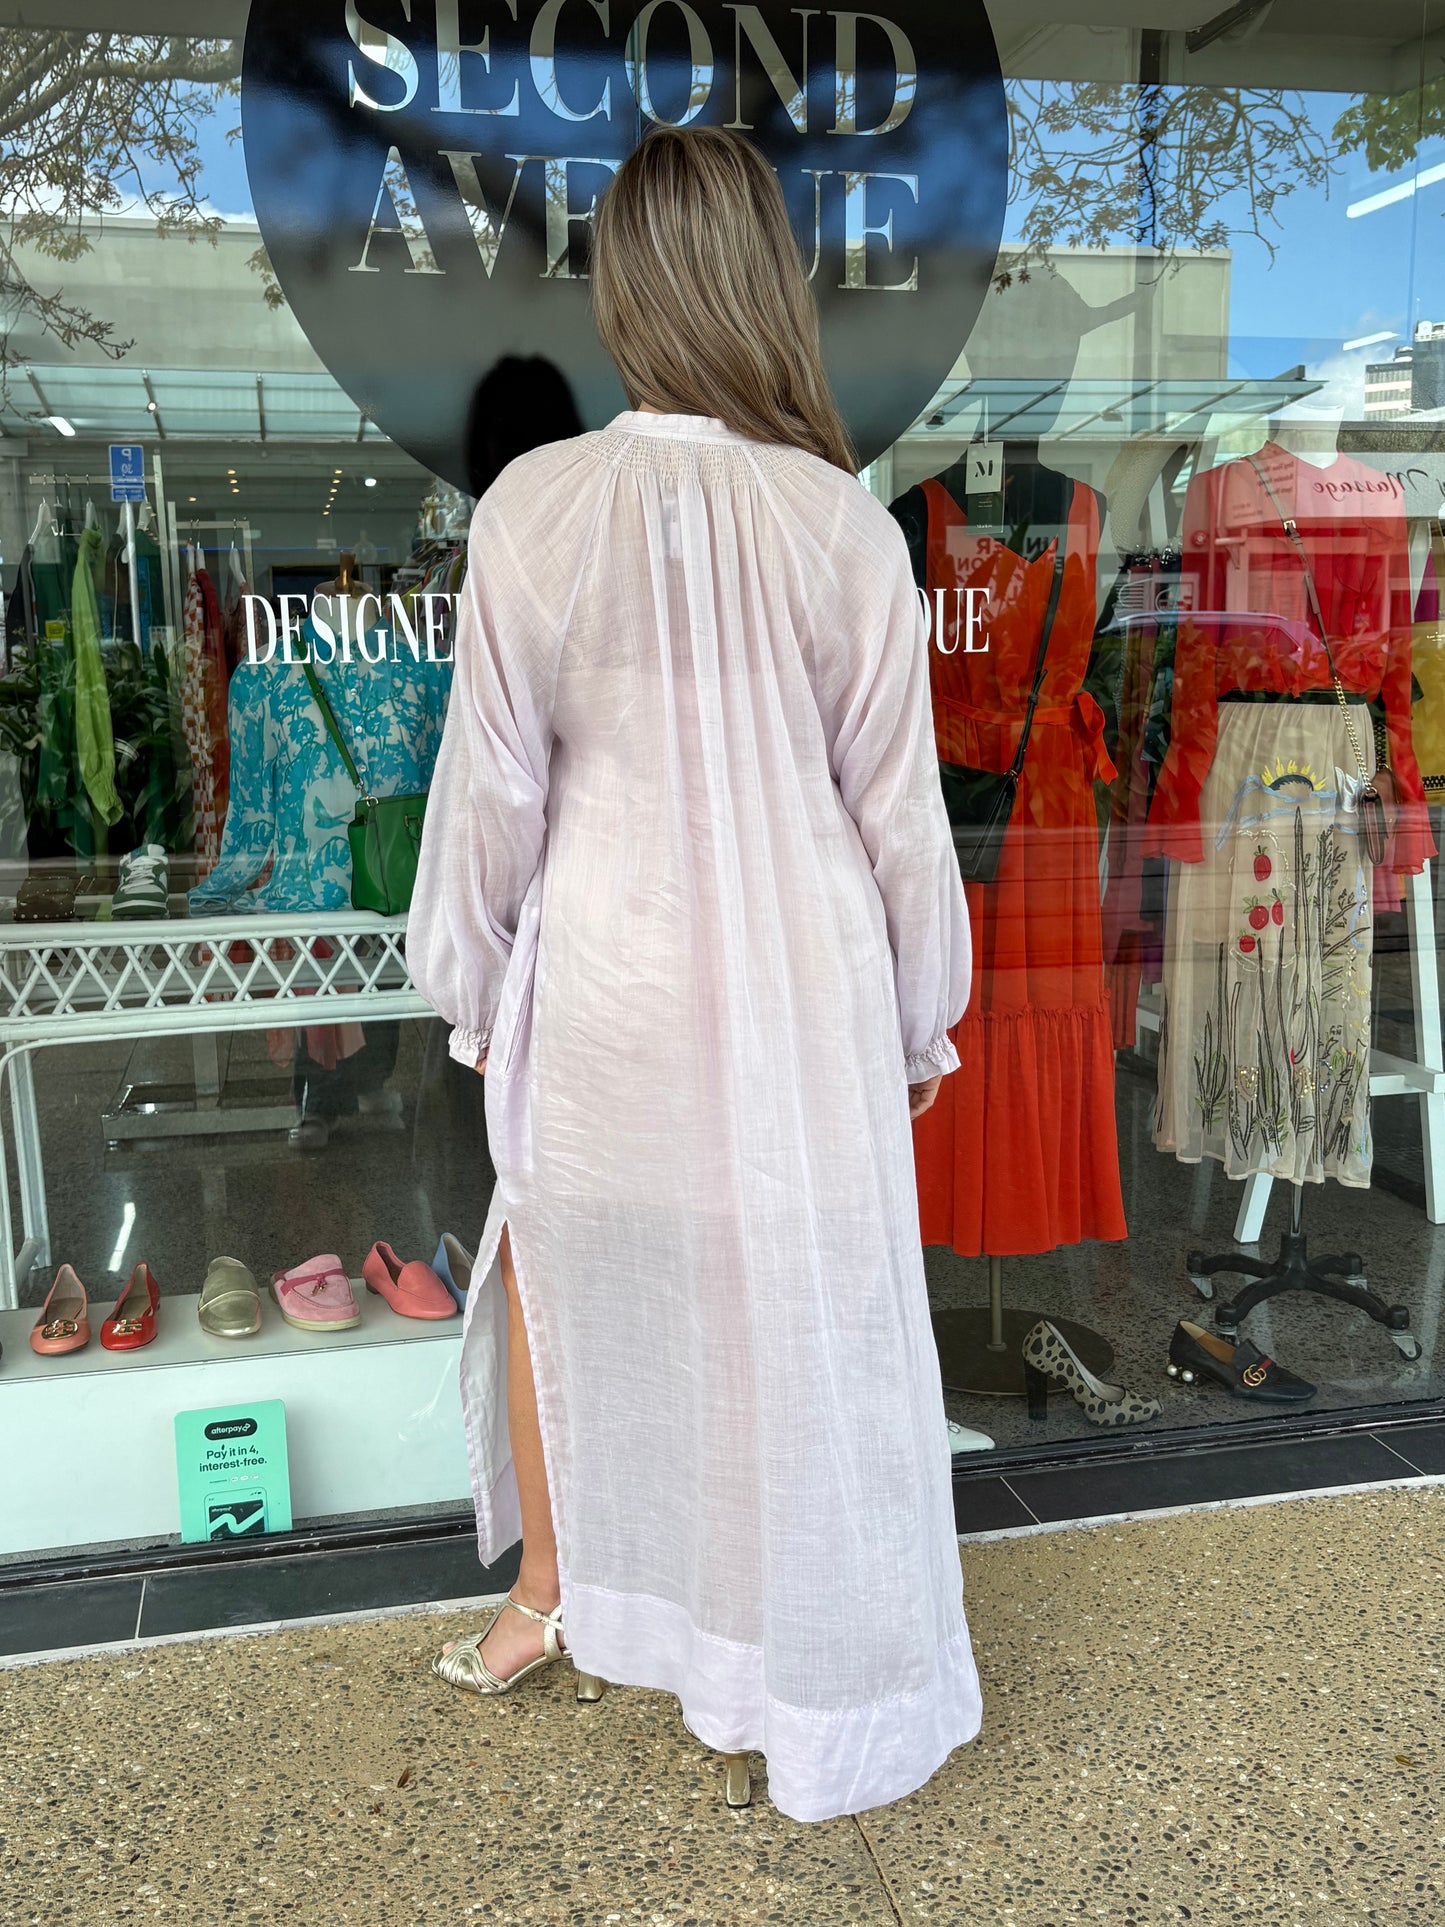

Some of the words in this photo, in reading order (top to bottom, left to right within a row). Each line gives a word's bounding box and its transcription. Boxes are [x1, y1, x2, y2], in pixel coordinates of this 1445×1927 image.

[345, 0, 917, 135] SECOND
[241, 593, 463, 665] DESIGNE
[211, 1425, 243, 1434] afterpay
[206, 1450, 227, 1460] Pay
[229, 1447, 236, 1457] it
[238, 1446, 247, 1456] in
[199, 1457, 268, 1472] interest-free.
